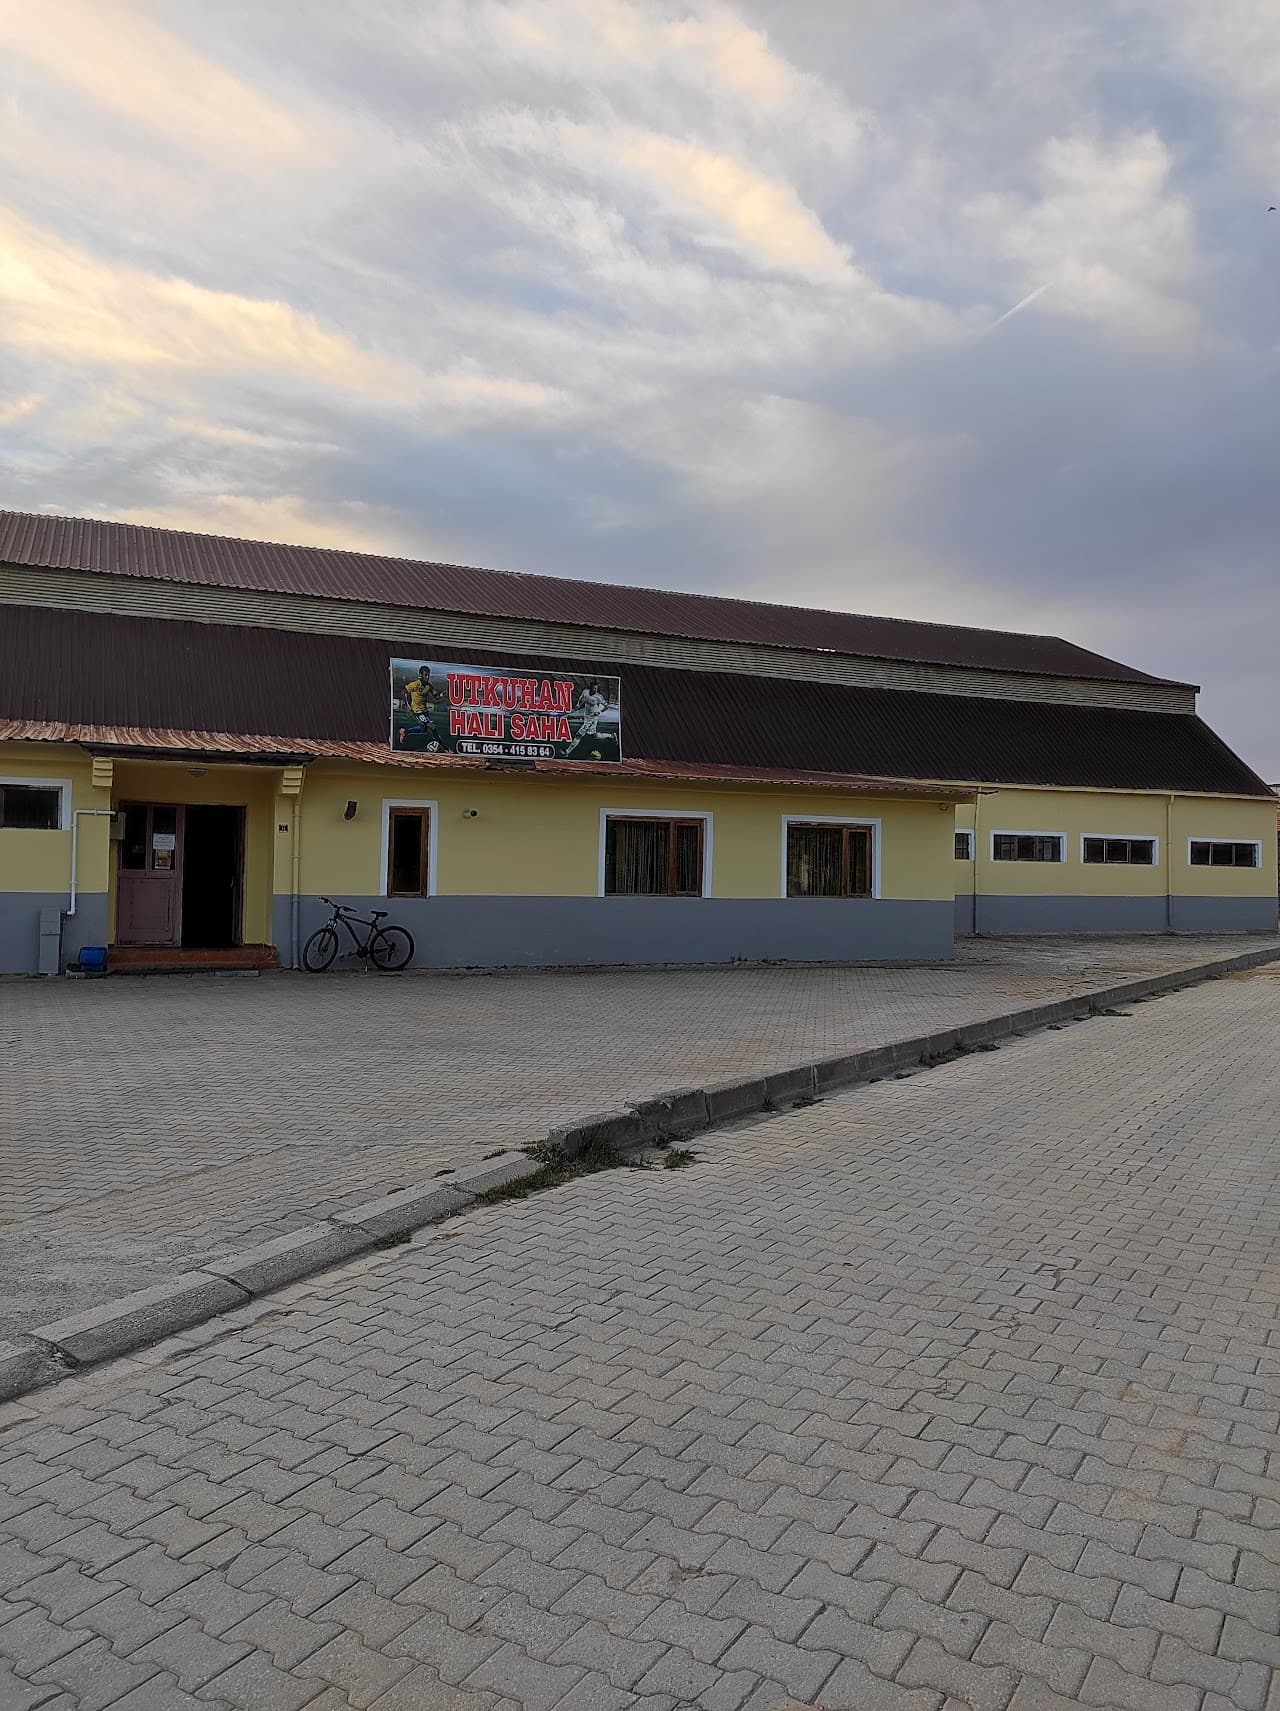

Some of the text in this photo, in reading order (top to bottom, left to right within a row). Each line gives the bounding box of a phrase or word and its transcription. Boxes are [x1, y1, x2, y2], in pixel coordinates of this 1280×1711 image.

[447, 673, 573, 712] UTKUHAN
[450, 710, 572, 742] HALI SAHA
[461, 742, 480, 753] TEL.
[483, 744, 503, 754] 0354
[510, 745, 525, 755] 415
